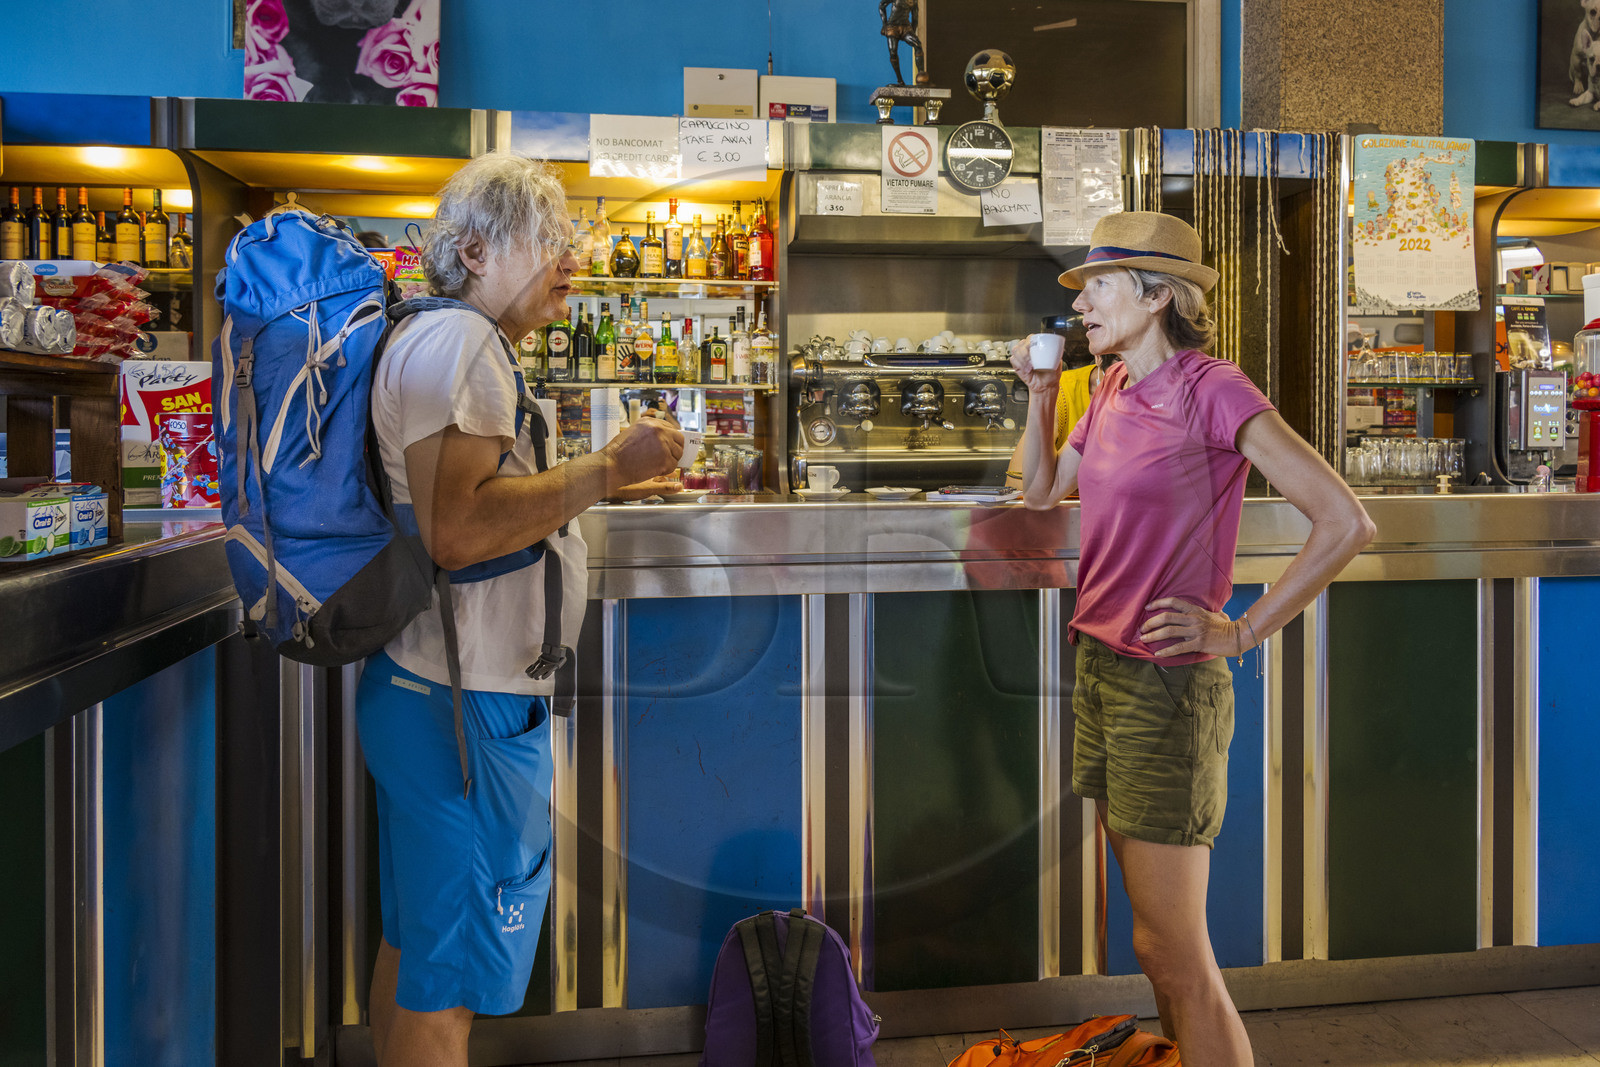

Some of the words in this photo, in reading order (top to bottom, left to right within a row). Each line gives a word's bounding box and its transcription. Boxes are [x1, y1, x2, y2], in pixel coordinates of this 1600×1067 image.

[680, 120, 750, 131] CAPPUCCINO
[974, 128, 985, 137] 12
[596, 138, 610, 146] NO
[612, 138, 663, 148] BANCOMAT
[682, 135, 714, 145] TAKE
[721, 135, 753, 145] AWAY
[994, 141, 1003, 149] 2
[1361, 138, 1409, 149] COLAZIONE
[1410, 139, 1471, 152] ALL'ITALIANA!
[612, 152, 643, 162] CREDIT
[645, 153, 669, 163] CARD
[713, 151, 741, 163] 3.00
[966, 170, 974, 179] 7
[975, 174, 984, 183] 6
[987, 171, 996, 179] 5
[886, 179, 909, 187] VIETATO
[910, 179, 934, 188] FUMARE
[990, 188, 1011, 199] NO
[1399, 237, 1432, 252] 2022
[139, 372, 199, 389] Party
[161, 391, 202, 412] SAN
[34, 517, 52, 528] Oral-B
